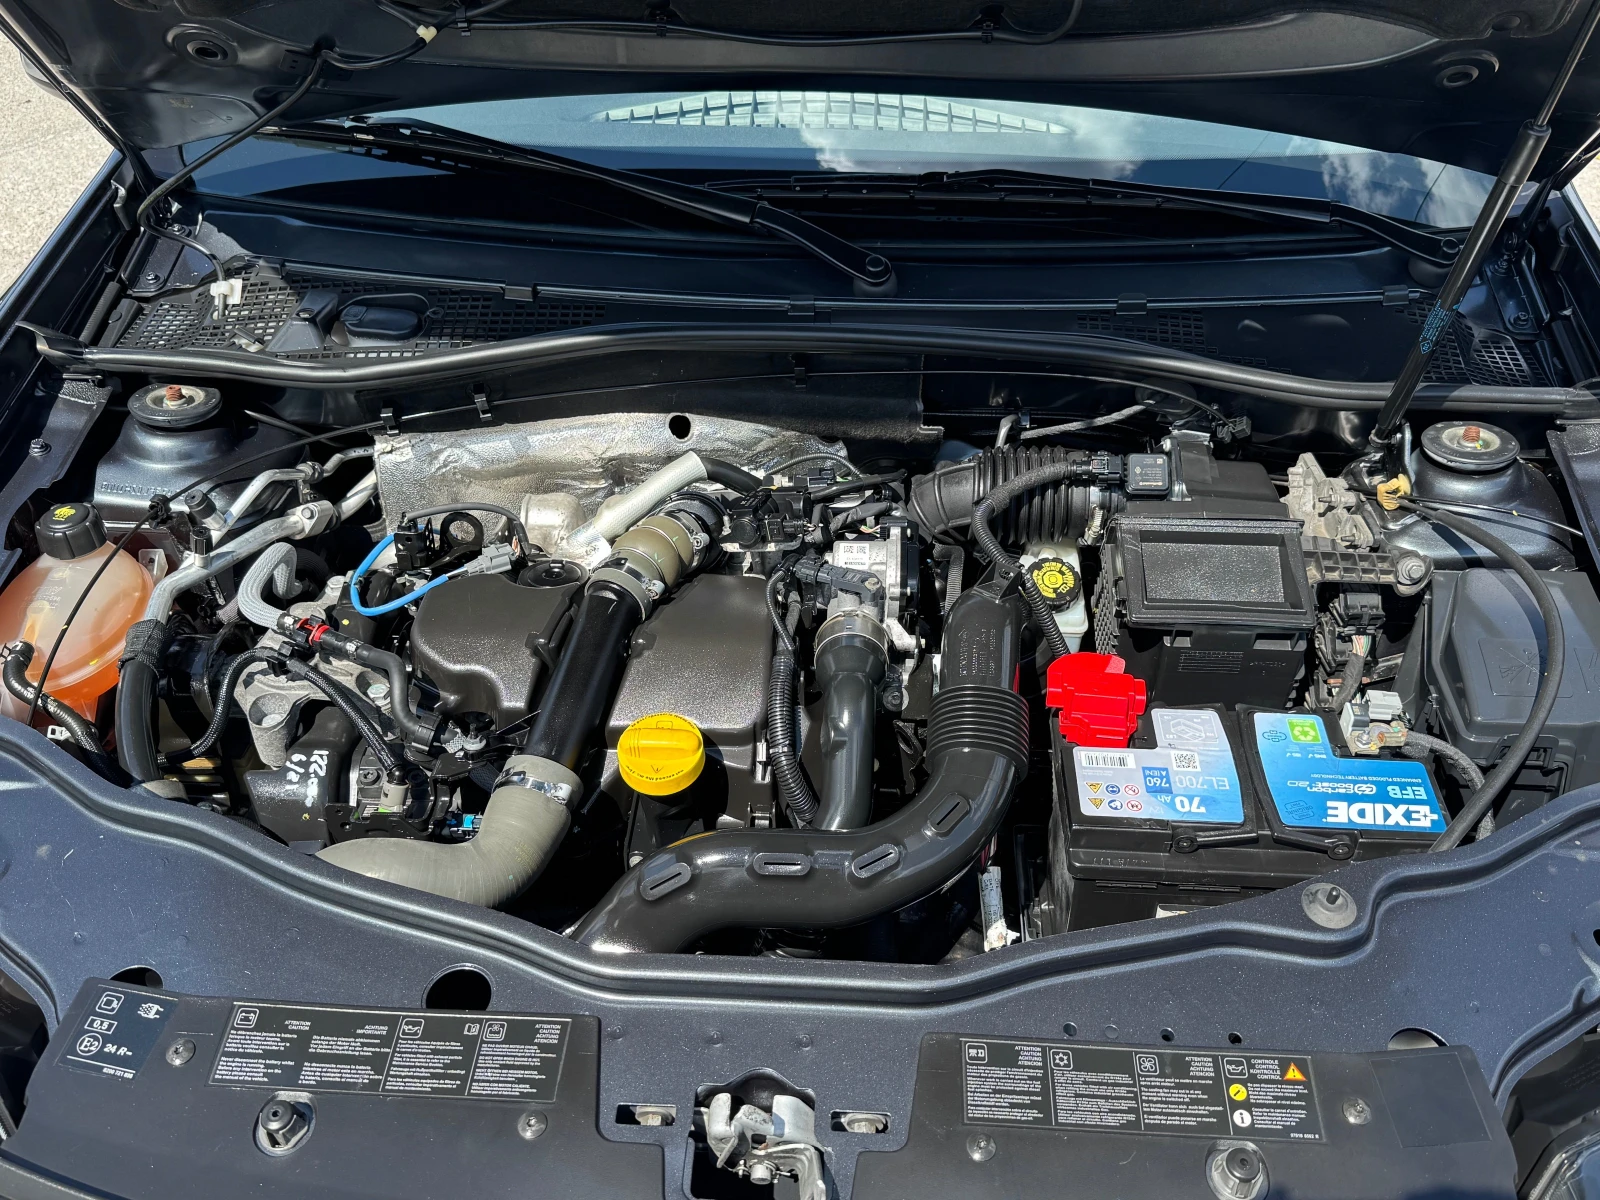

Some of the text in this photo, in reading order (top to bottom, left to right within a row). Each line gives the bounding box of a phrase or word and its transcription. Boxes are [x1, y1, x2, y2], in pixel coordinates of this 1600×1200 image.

[1146, 777, 1169, 788] 760
[1175, 776, 1230, 790] EL700
[1307, 787, 1354, 795] carbon
[1387, 786, 1427, 800] EFB
[1157, 795, 1206, 813] 70 Ah
[1327, 801, 1438, 828] EXIDE
[92, 1020, 109, 1031] 0,5
[80, 1037, 98, 1051] E2
[104, 1043, 116, 1053] 24
